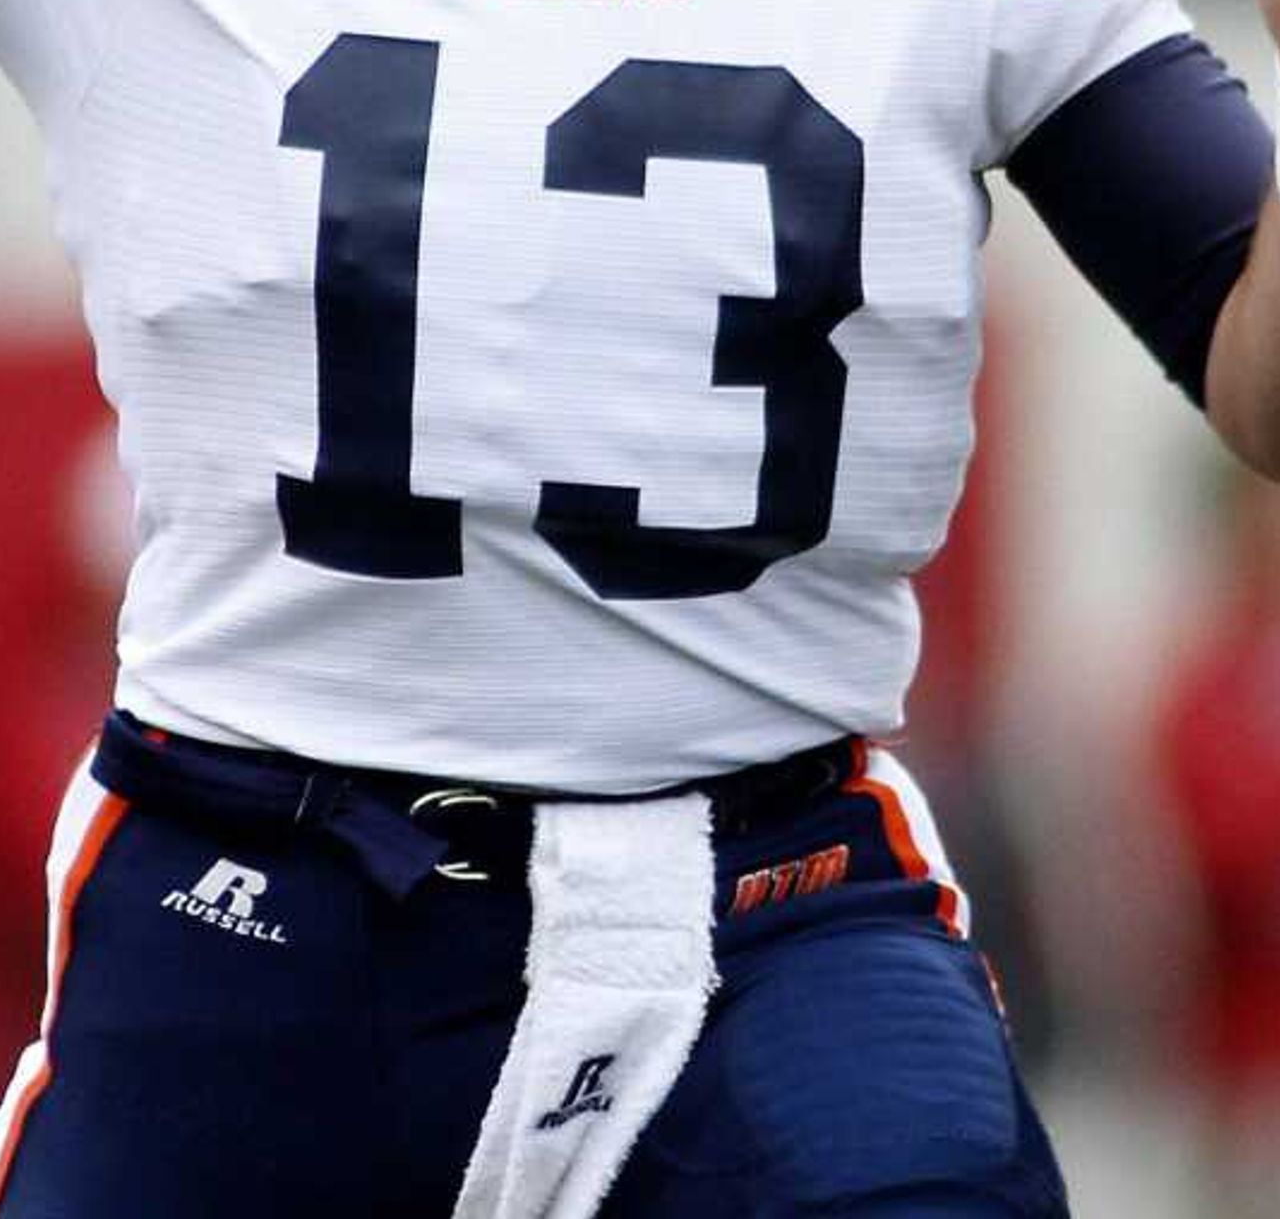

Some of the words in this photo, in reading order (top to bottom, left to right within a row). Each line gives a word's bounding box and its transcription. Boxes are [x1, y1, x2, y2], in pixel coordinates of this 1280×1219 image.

[275, 31, 865, 601] 13
[161, 890, 286, 943] RUSSELL
[190, 857, 267, 918] R
